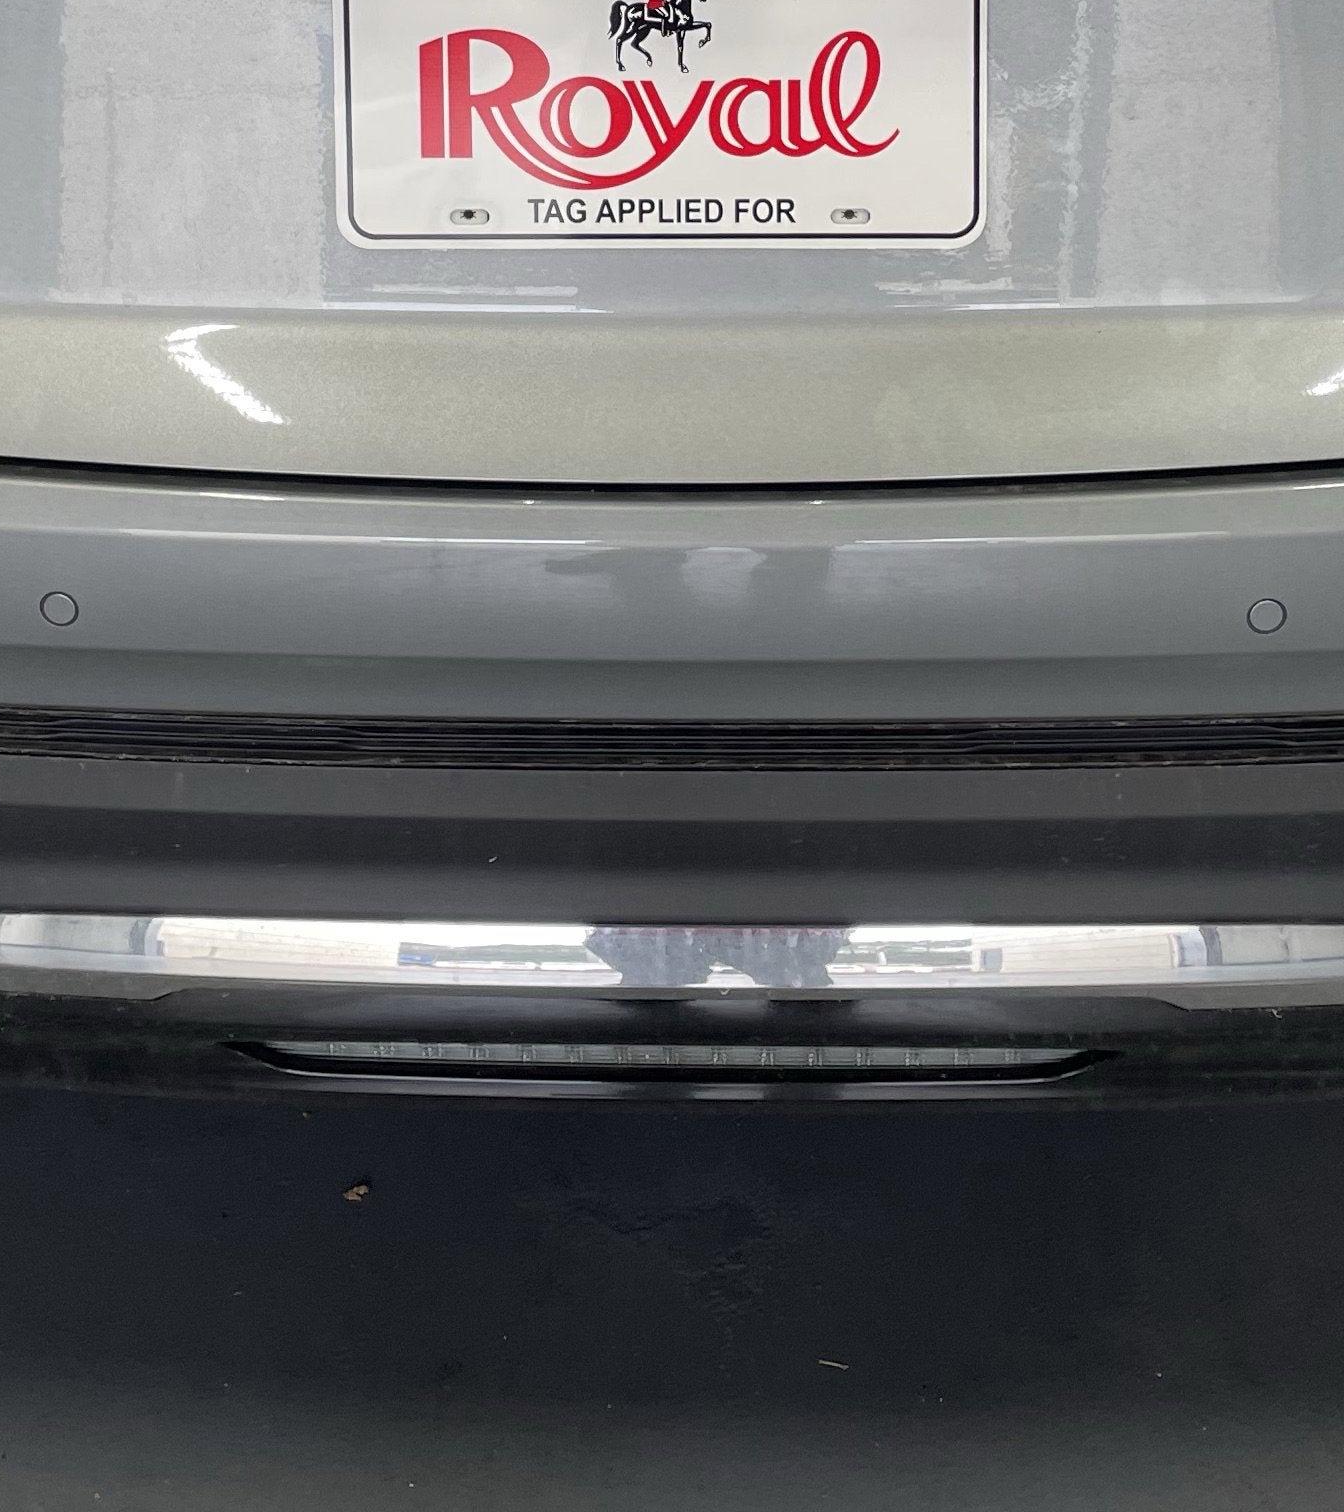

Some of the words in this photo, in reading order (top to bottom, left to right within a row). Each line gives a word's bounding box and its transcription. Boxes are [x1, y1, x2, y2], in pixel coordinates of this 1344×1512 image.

[418, 28, 901, 191] Royal
[527, 198, 587, 224] TAG
[594, 198, 724, 224] APPLIED
[734, 198, 797, 224] FOR
